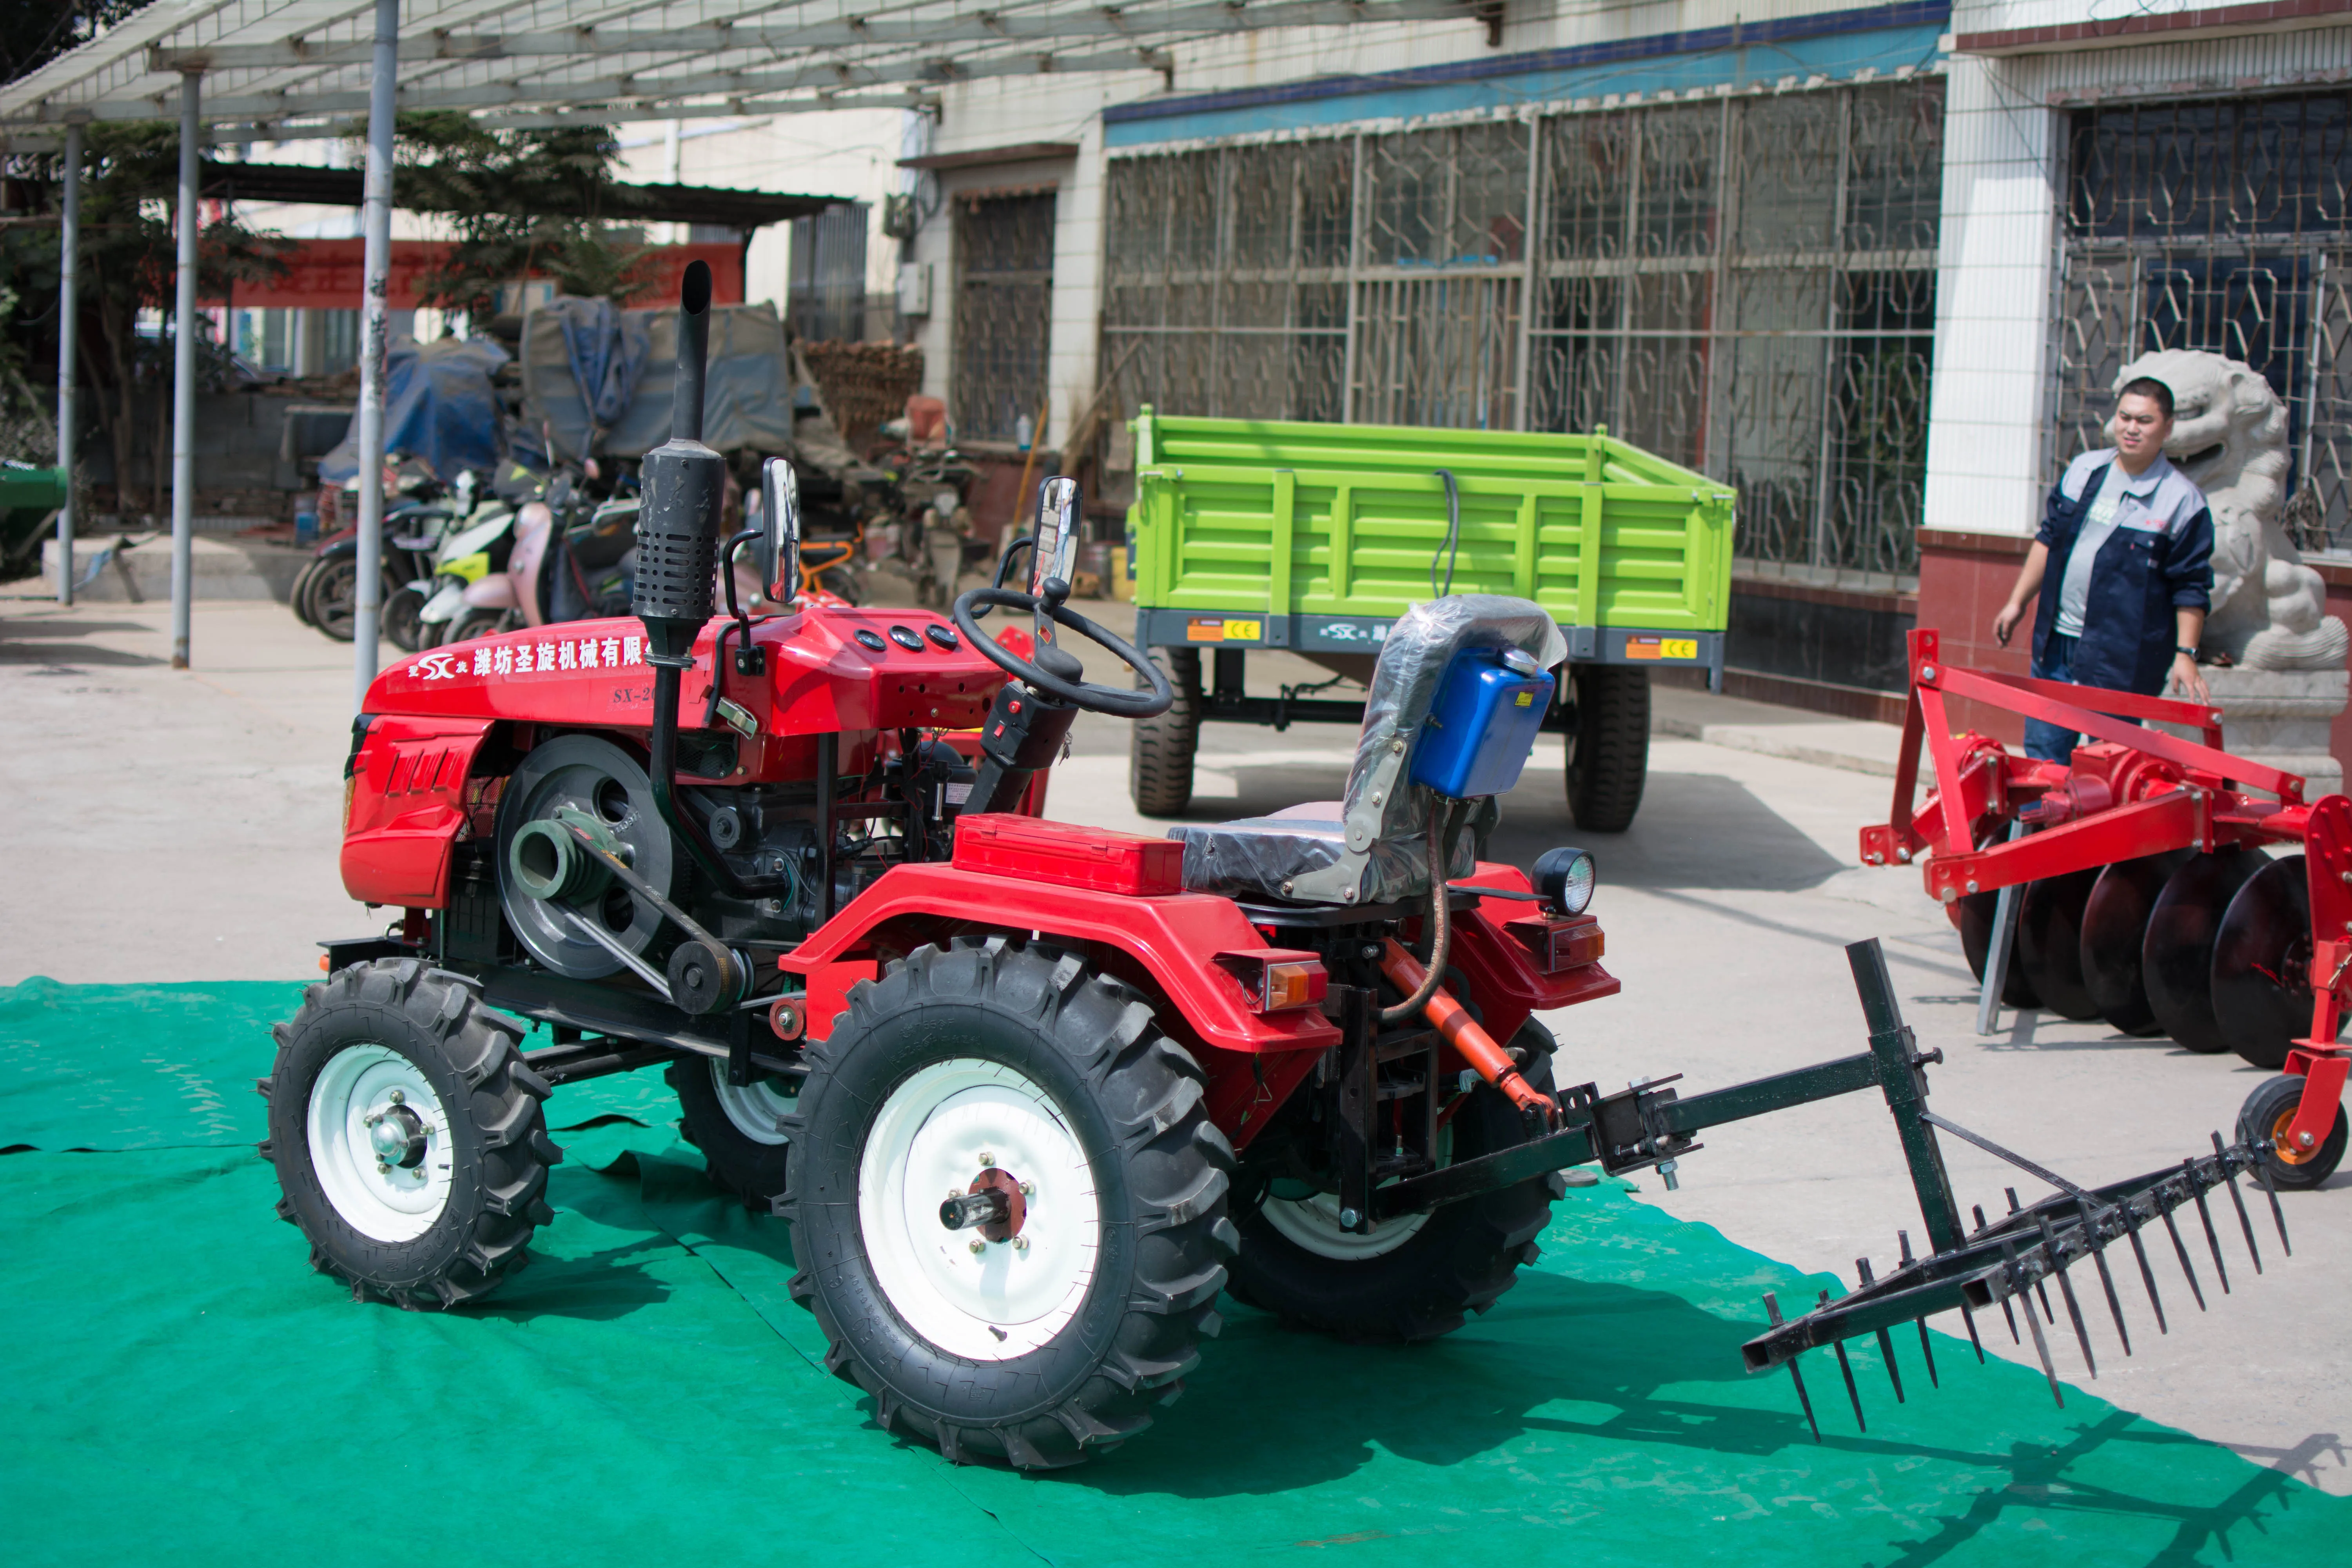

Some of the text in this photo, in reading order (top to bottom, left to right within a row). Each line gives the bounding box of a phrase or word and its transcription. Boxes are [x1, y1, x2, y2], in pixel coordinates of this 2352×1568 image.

[473, 636, 653, 677] 潍坊圣旋机械有限
